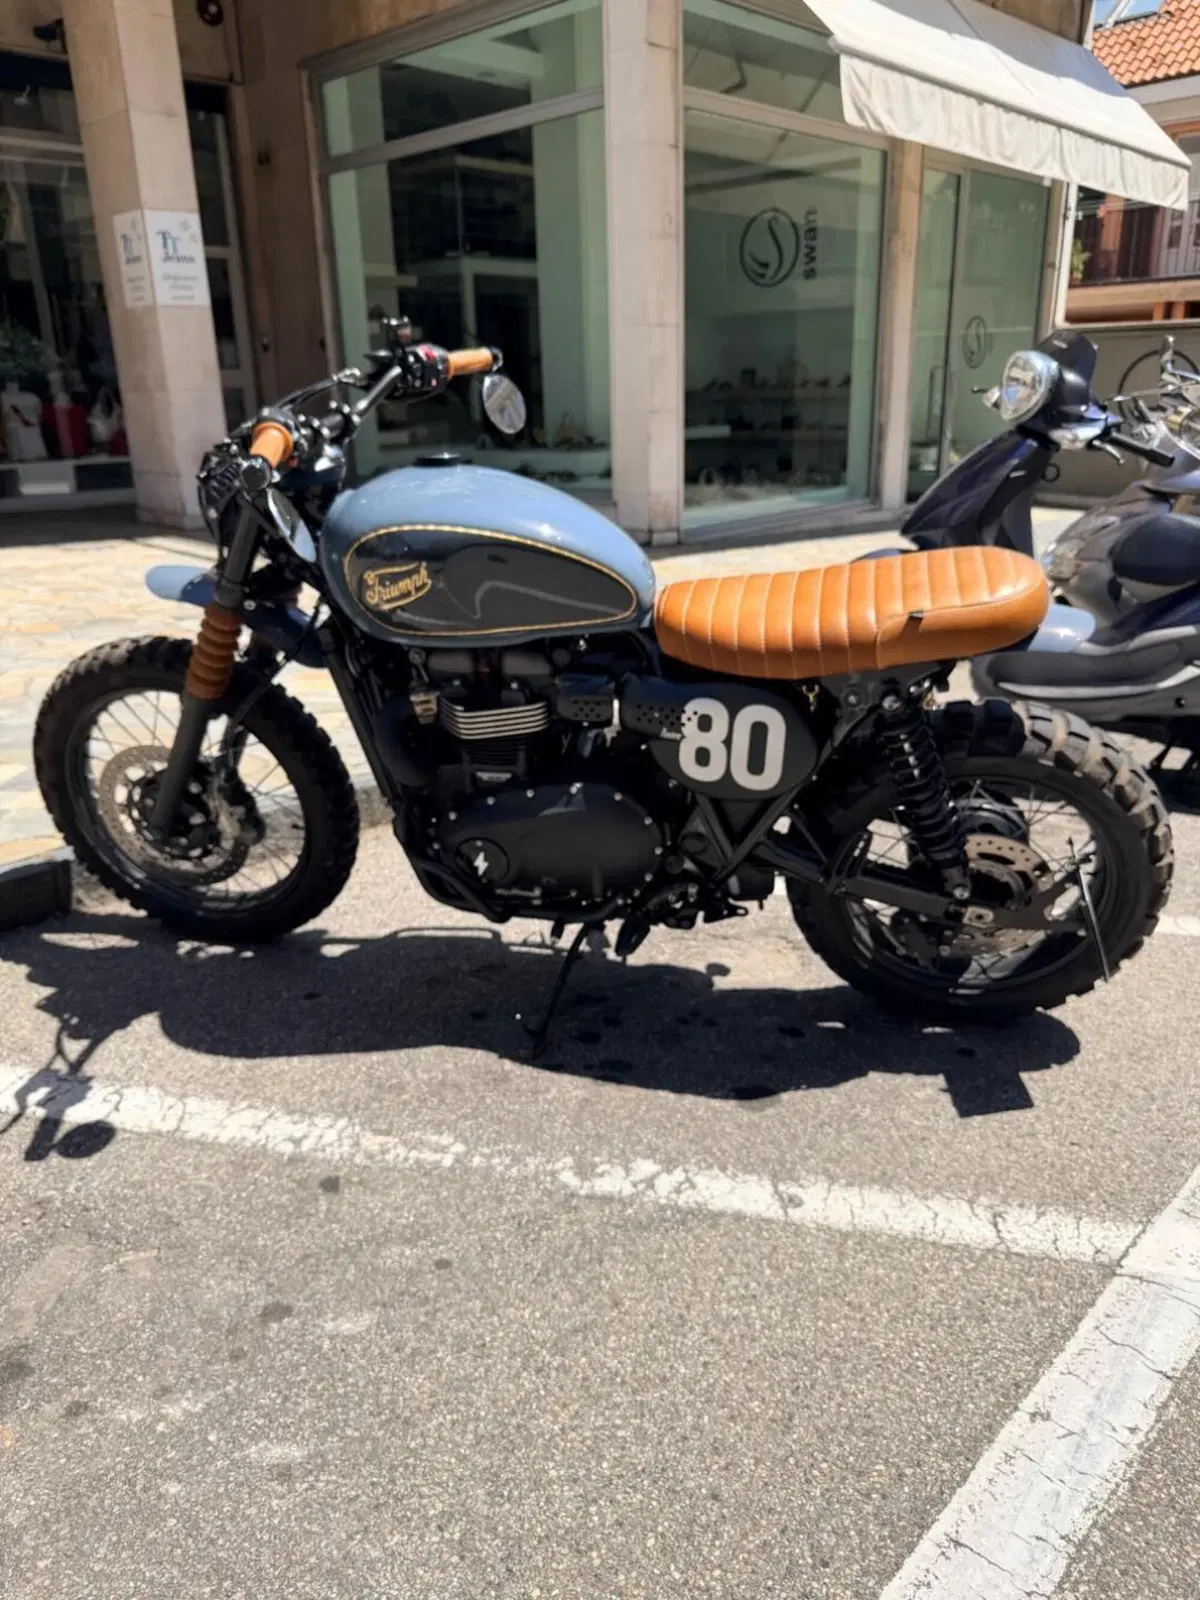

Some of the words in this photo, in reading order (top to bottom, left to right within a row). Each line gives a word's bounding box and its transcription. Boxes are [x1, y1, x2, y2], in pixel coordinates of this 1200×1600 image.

[803, 208, 818, 280] swan
[363, 561, 432, 610] Triumph
[678, 697, 787, 791] 80
